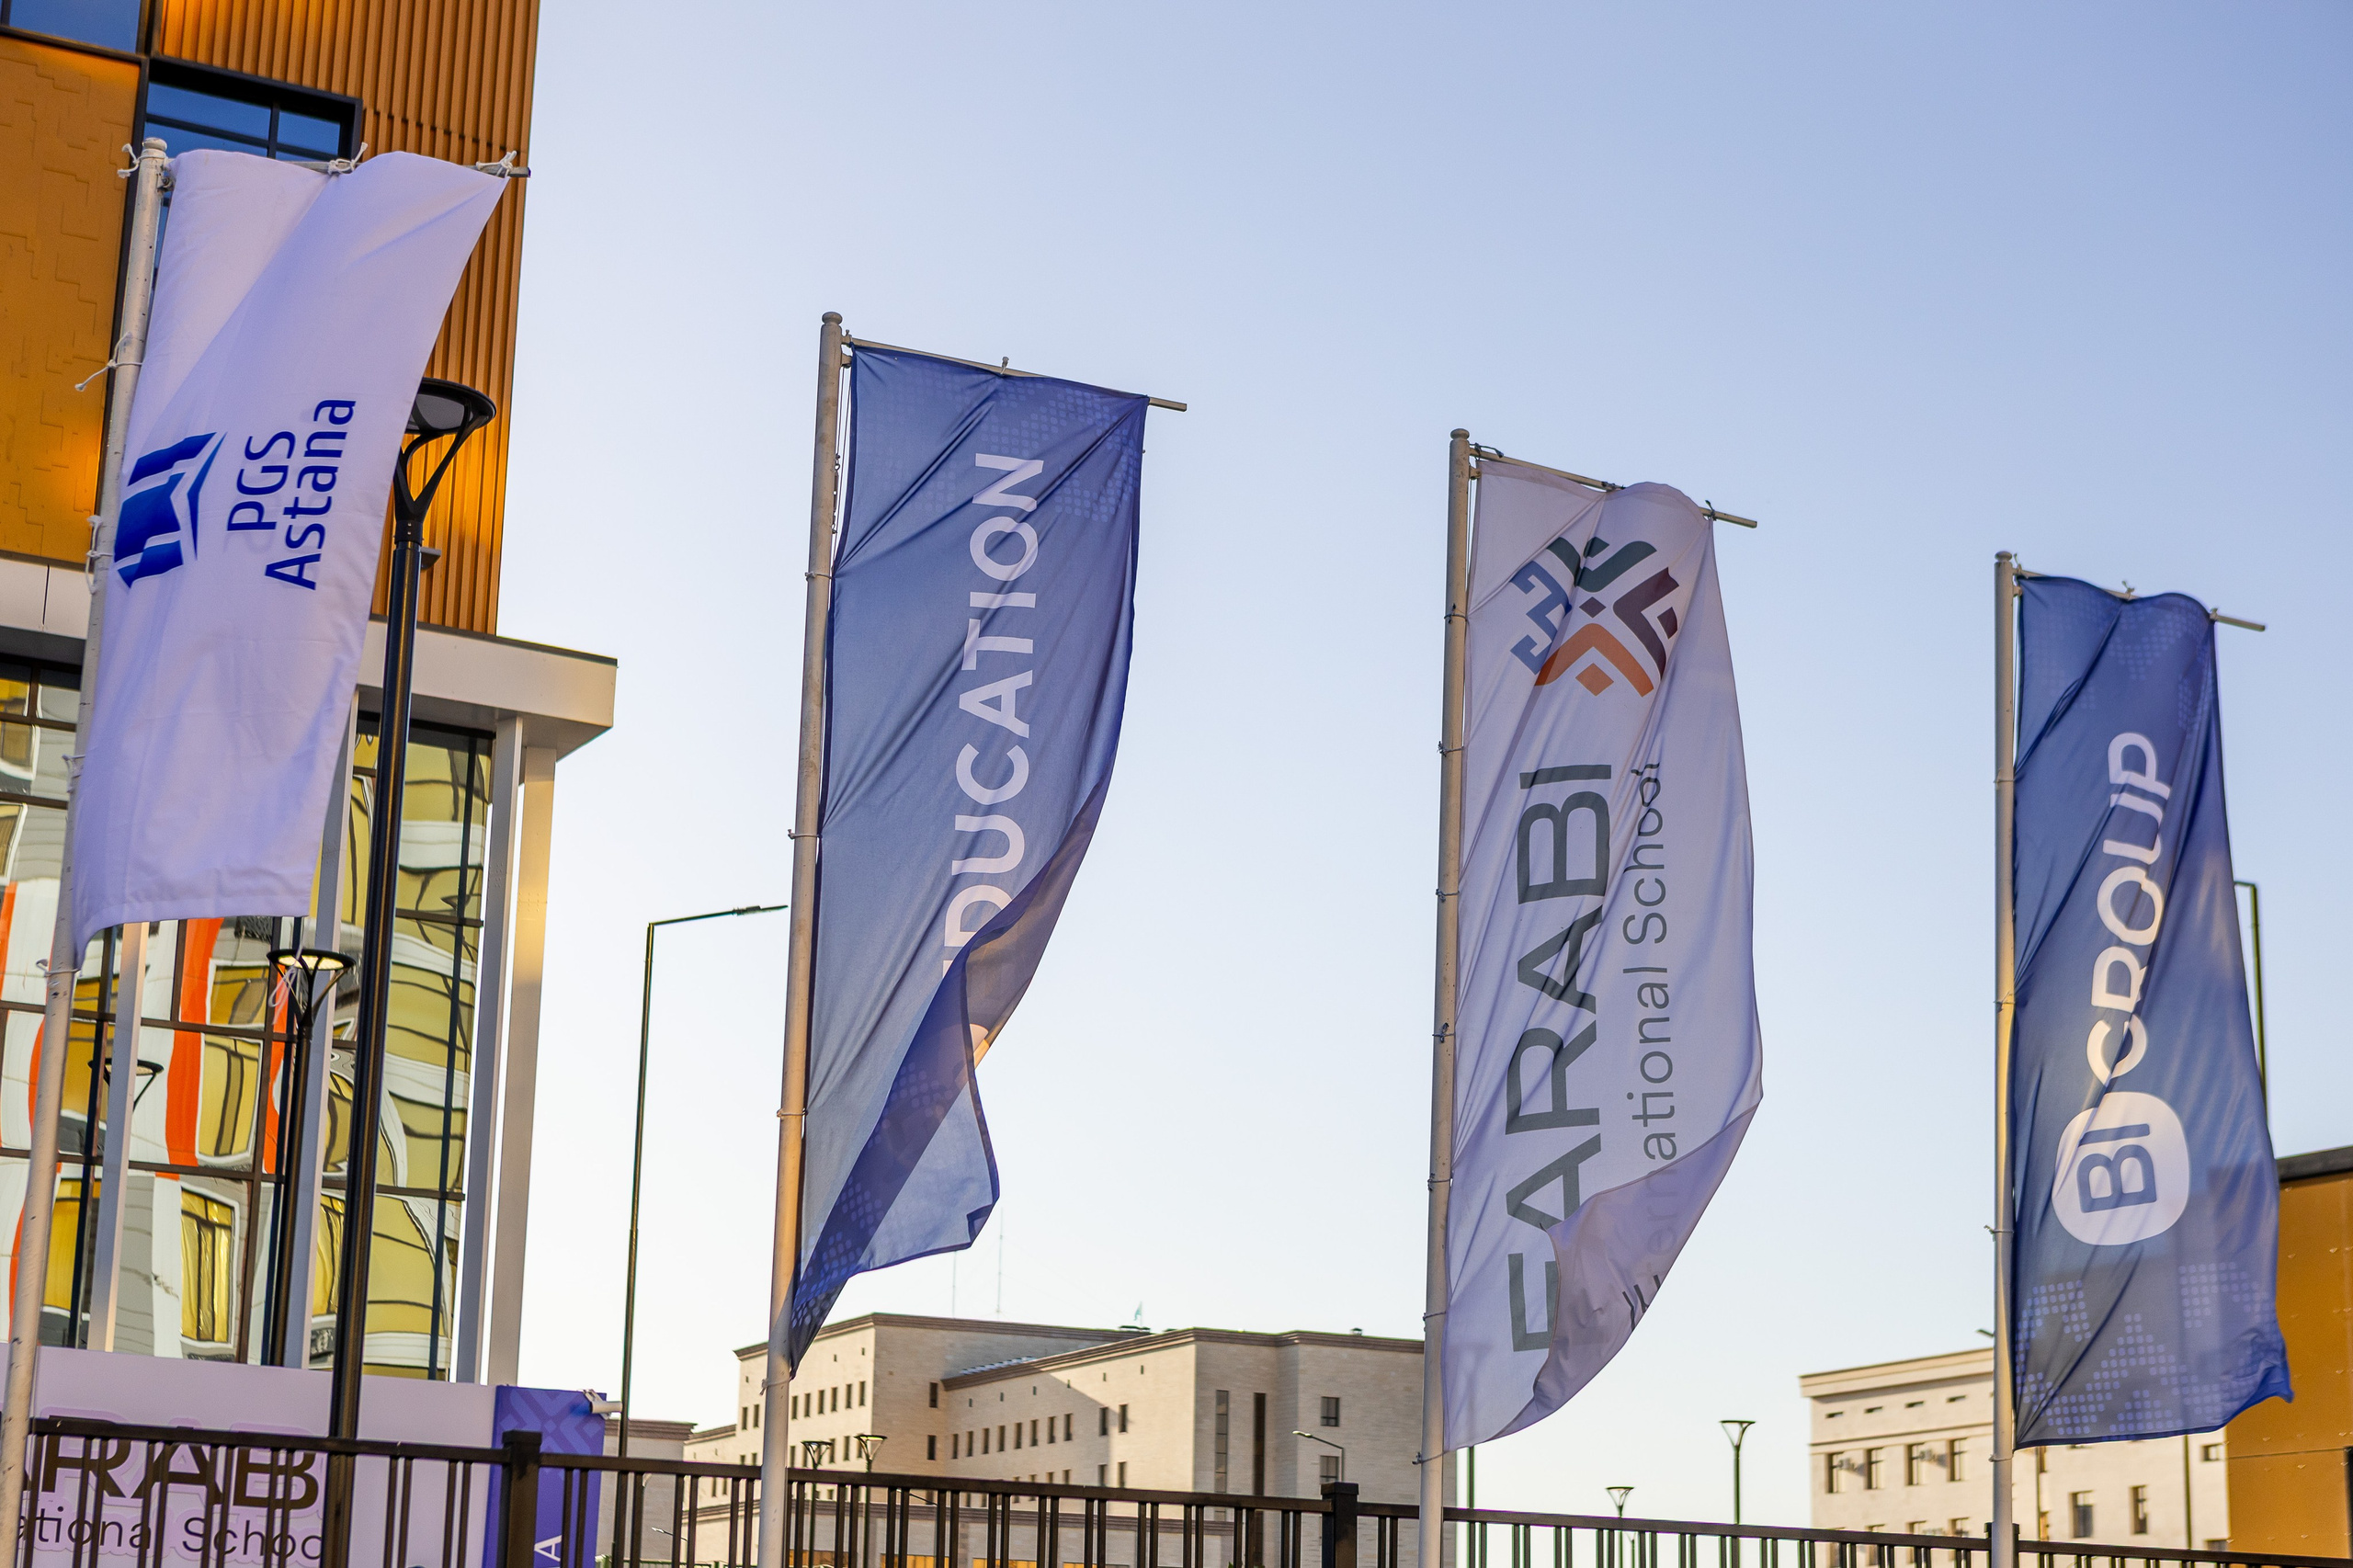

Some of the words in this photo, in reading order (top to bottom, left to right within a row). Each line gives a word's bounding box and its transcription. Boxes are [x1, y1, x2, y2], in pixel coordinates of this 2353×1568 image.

[227, 430, 296, 531] PGS
[264, 399, 357, 591] Astana
[942, 453, 1044, 979] DUCATION
[1622, 762, 1668, 945] School
[2086, 733, 2171, 1086] GROUP
[1622, 966, 1678, 1161] ational
[2077, 1123, 2158, 1214] BI
[182, 1517, 322, 1561] Schoo
